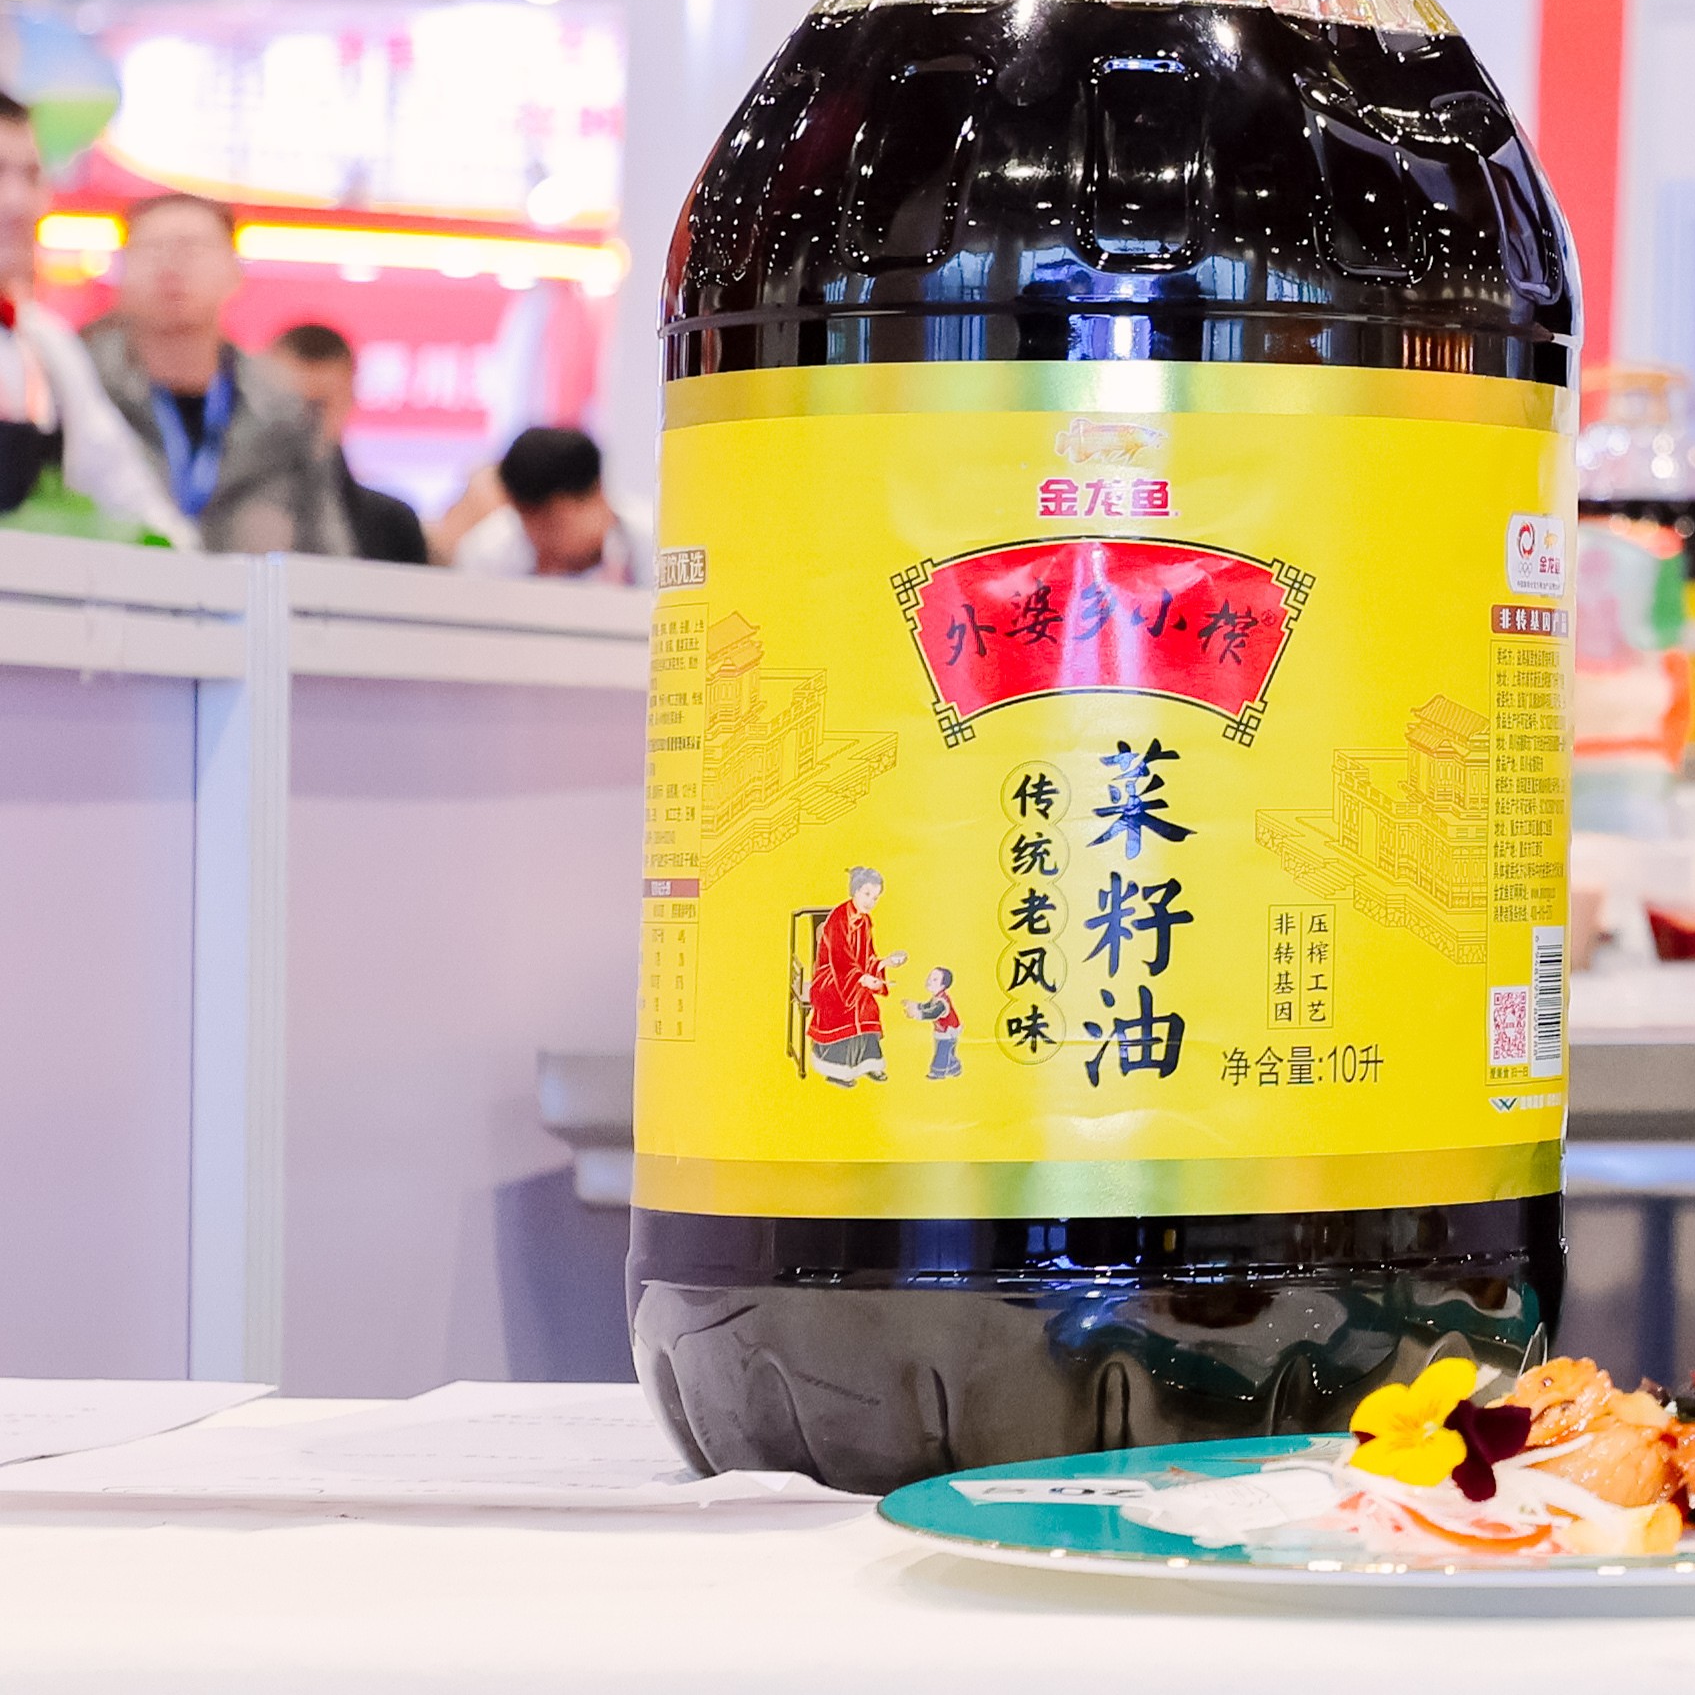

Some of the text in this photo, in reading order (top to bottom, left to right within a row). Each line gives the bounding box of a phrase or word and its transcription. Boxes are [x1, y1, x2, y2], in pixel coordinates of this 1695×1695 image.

[1039, 479, 1169, 516] 金龙鱼
[1007, 773, 1059, 1053] 传统老风味
[1082, 738, 1197, 1087] 菜籽油
[1273, 913, 1295, 1022] 非转基因
[1307, 913, 1329, 1022] 压榨工艺
